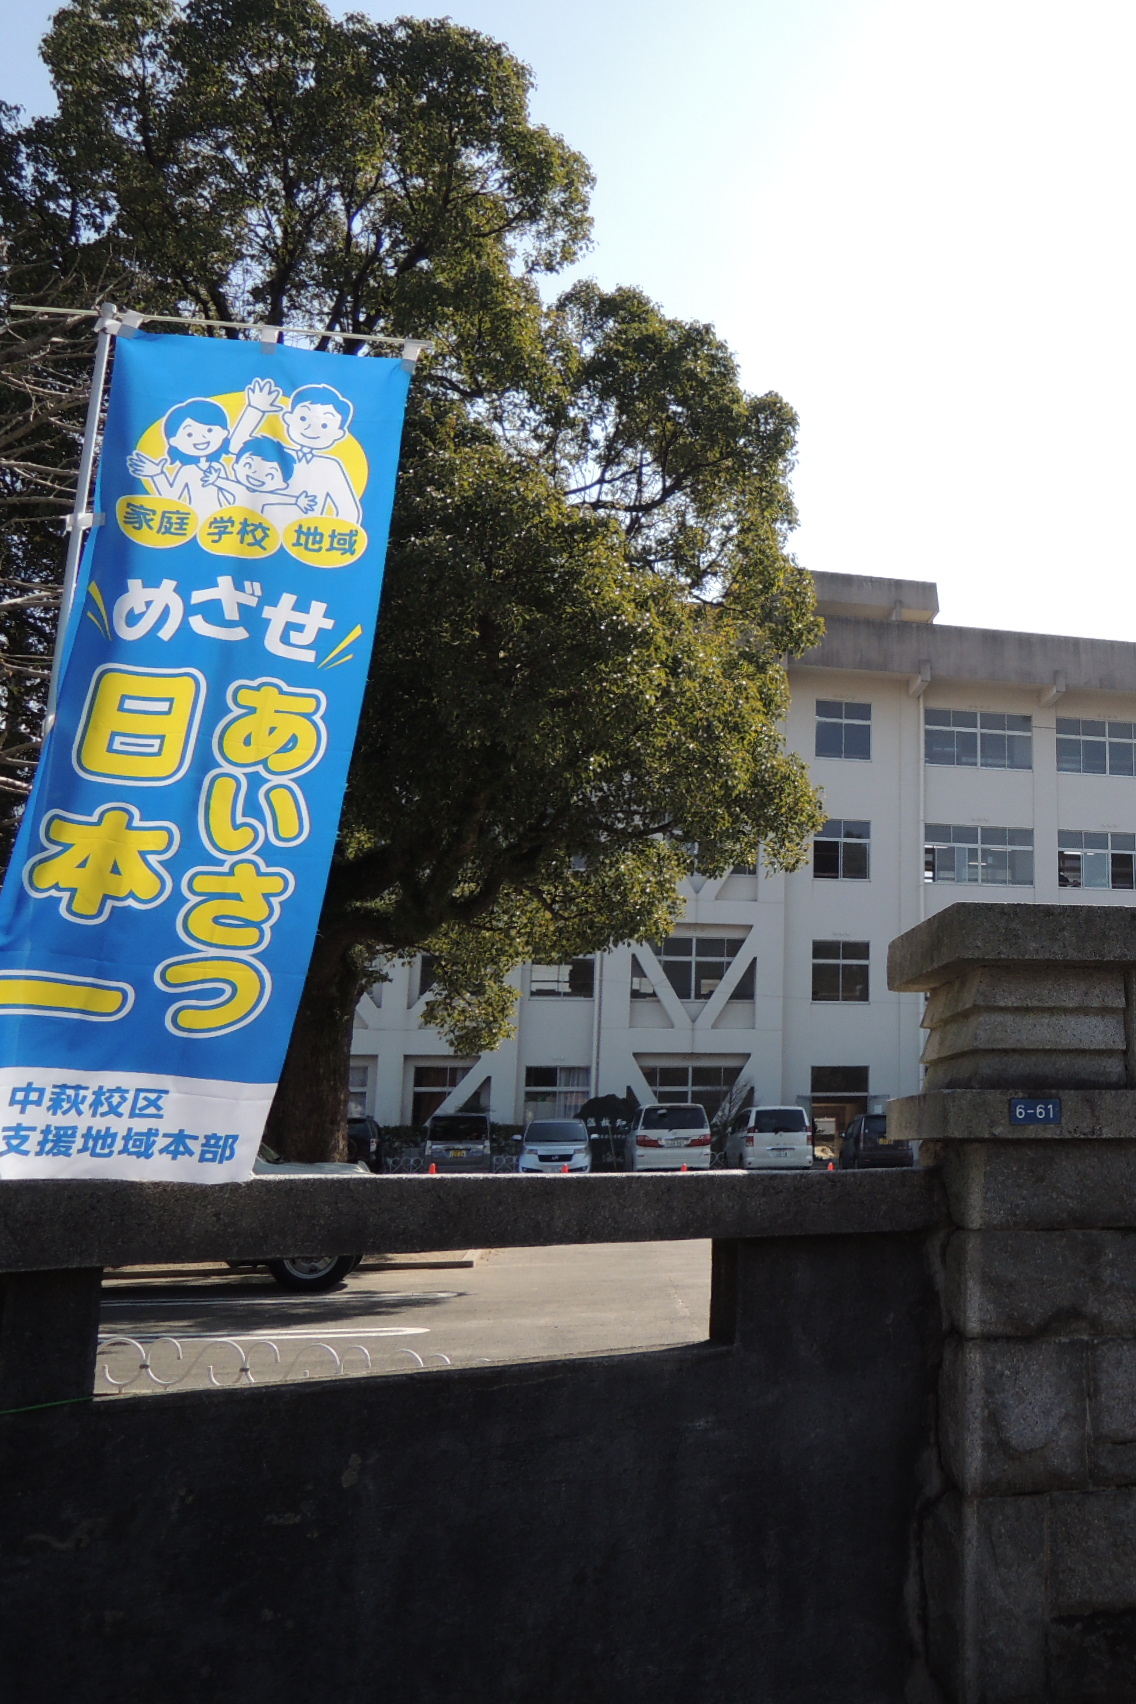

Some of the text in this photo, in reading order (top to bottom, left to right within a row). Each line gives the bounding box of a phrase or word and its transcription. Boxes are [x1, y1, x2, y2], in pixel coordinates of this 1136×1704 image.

[123, 503, 192, 538] 家庭
[206, 515, 269, 552] 学校
[292, 523, 359, 557] 地域
[113, 575, 335, 664] めざせ
[0, 663, 206, 1022] 日本一
[154, 677, 327, 1038] あいさつ
[10, 1081, 170, 1120] 中萩校区
[1016, 1104, 1053, 1119] 6-61
[1, 1123, 240, 1165] 支援地域本部
